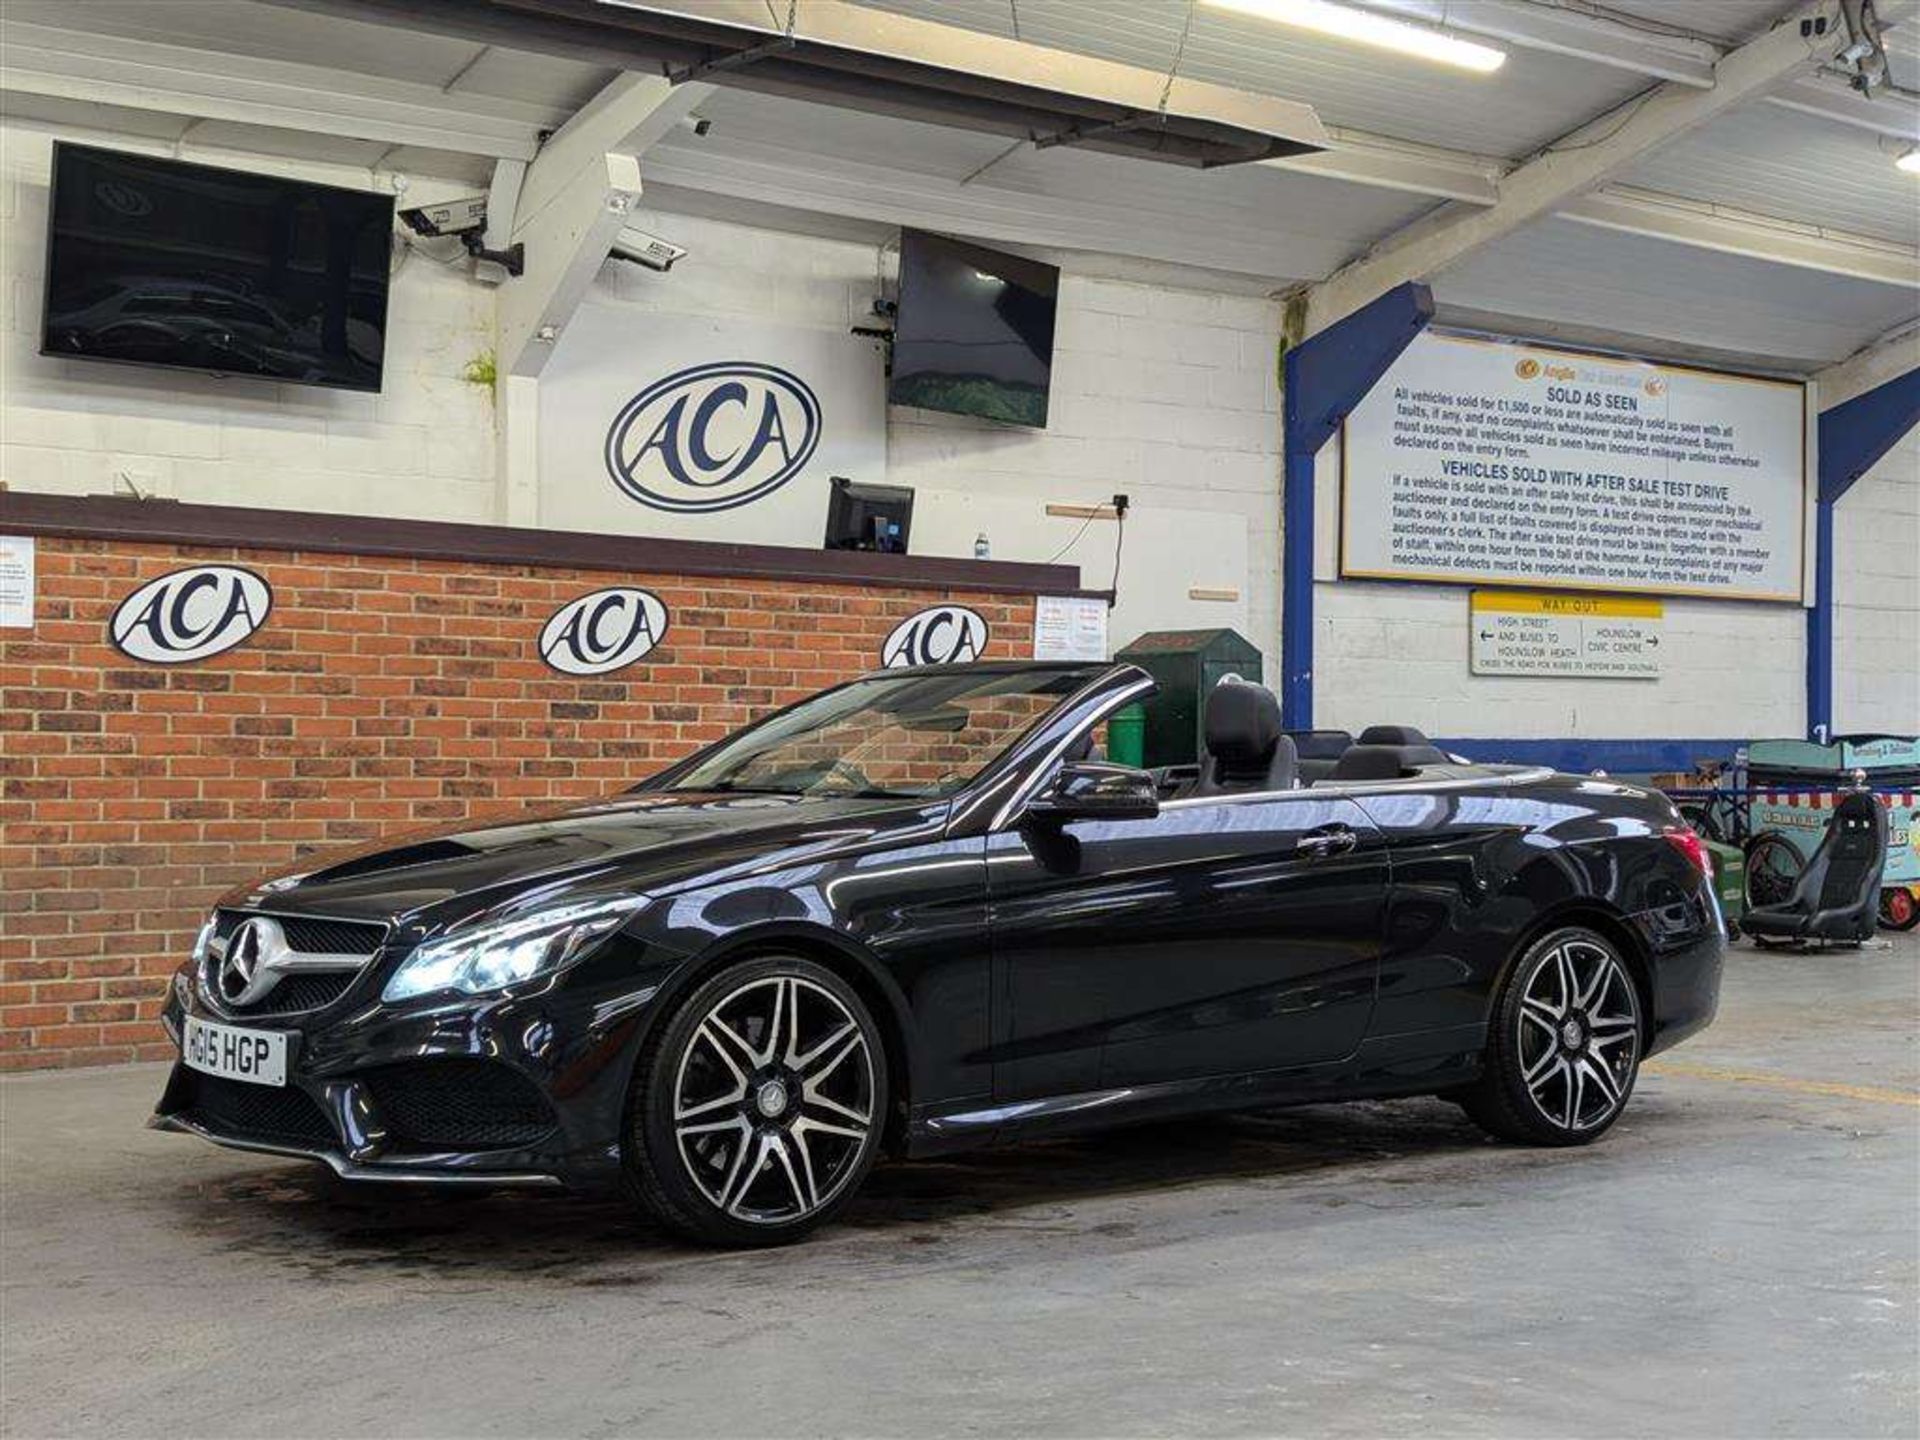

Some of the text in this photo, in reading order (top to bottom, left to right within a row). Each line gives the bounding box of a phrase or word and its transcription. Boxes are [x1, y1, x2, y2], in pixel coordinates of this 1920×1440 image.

[1394, 387, 1409, 399] All
[1410, 389, 1453, 404] vehicles
[1455, 394, 1478, 407] sold
[1479, 397, 1495, 409] for
[1531, 405, 1542, 414] or
[1543, 405, 1564, 417] less
[1565, 409, 1581, 419] are
[1583, 409, 1643, 428] automatically
[1645, 417, 1665, 428] sold
[1546, 387, 1638, 411] SOLD AS SEEN
[624, 381, 796, 487] ACA
[1393, 418, 1420, 432] must
[1422, 424, 1463, 436] assume
[1464, 426, 1478, 438] all
[1480, 428, 1521, 442] vehicles
[1522, 432, 1544, 444] sold
[1559, 438, 1583, 448] seen
[1584, 439, 1607, 451] have
[1608, 441, 1650, 455] incorrect
[1651, 446, 1686, 461] mileage
[1688, 450, 1716, 462] unless
[1718, 453, 1759, 467] otherwise
[1393, 434, 1439, 449] declared
[1440, 441, 1455, 451] on
[1456, 441, 1474, 452] the
[1475, 442, 1502, 457] entry
[1464, 411, 1484, 423] and
[1485, 415, 1500, 425] no
[1501, 415, 1555, 433] complaints
[1556, 421, 1610, 437] whatsoever
[1612, 427, 1634, 439] shall
[1635, 430, 1647, 441] be
[1703, 438, 1733, 452] Buyers
[1393, 475, 1401, 486] If
[1412, 477, 1449, 490] vehicle
[1462, 481, 1486, 493] sold
[1487, 484, 1509, 495] with
[1510, 488, 1523, 497] an
[1525, 487, 1547, 499] after
[1549, 489, 1569, 500] sale
[1570, 491, 1590, 502] test
[1619, 495, 1637, 506] this
[1639, 497, 1661, 508] shall
[1662, 499, 1675, 509] be
[1676, 500, 1724, 514] announced
[1724, 505, 1736, 517] by
[1737, 506, 1751, 516] the
[1441, 459, 1729, 500] VEHICLES SOLD WITH AFTER SALE TEST DRIVE
[1392, 491, 1447, 505] auctioneer
[1449, 495, 1470, 507] and
[1471, 497, 1516, 511] declared
[1517, 503, 1530, 512] on
[1531, 502, 1547, 513] the
[1549, 504, 1574, 518] entry
[1602, 508, 1609, 518] A
[1611, 509, 1630, 520] test
[1630, 510, 1654, 522] drive
[1655, 514, 1686, 525] covers
[1688, 517, 1713, 529] major
[1714, 517, 1762, 531] mechanical
[1392, 506, 1422, 519] faults
[1459, 511, 1476, 523] full
[1478, 513, 1495, 524] list
[1496, 514, 1508, 525] of
[1508, 515, 1536, 527] faults
[1538, 517, 1577, 530] covered
[1589, 521, 1634, 537] displayed
[1635, 525, 1645, 535] in
[1646, 526, 1661, 536] the
[1662, 527, 1688, 538] office
[1690, 529, 1707, 540] and
[1708, 531, 1727, 541] with
[1727, 532, 1742, 542] the
[1392, 537, 1404, 548] of
[1433, 540, 1465, 552] within
[1467, 544, 1487, 553] one
[1488, 544, 1512, 555] hour
[1513, 546, 1537, 557] from
[1538, 547, 1554, 558] the
[1555, 548, 1572, 559] fall
[1573, 550, 1583, 560] of
[1584, 550, 1600, 561] the
[1643, 554, 1661, 567] Any
[1662, 556, 1710, 570] complaints
[1711, 559, 1721, 568] of
[1722, 562, 1738, 572] any
[1739, 563, 1762, 573] major
[1488, 529, 1506, 540] The
[1509, 530, 1531, 541] after
[1534, 532, 1554, 543] sale
[1555, 534, 1574, 544] test
[1575, 535, 1600, 546] drive
[1601, 537, 1625, 548] must
[1626, 539, 1638, 549] be
[1670, 542, 1707, 556] together
[1708, 545, 1727, 555] with
[1735, 547, 1770, 558] member
[1392, 552, 1452, 566] mechanical
[1452, 556, 1491, 569] defects
[1493, 559, 1518, 570] must
[1519, 561, 1532, 571] be
[1534, 561, 1576, 576] reported
[1577, 564, 1606, 576] within
[1607, 568, 1625, 577] one
[1626, 567, 1648, 578] hour
[1649, 569, 1671, 579] from
[1672, 570, 1687, 580] the
[1688, 571, 1706, 582] test
[117, 572, 256, 651] ACA
[1522, 618, 1549, 628] STREET
[1541, 600, 1601, 612] WAY OUT
[544, 593, 655, 664] ACA
[886, 611, 978, 668] ACA
[1499, 632, 1559, 643] AND BUSES TO
[1597, 629, 1642, 639] HOUNSLOW
[1498, 646, 1577, 657] HOUNSLOW HEATH
[1613, 643, 1642, 653] CENTRE
[223, 1032, 269, 1075] HGP
